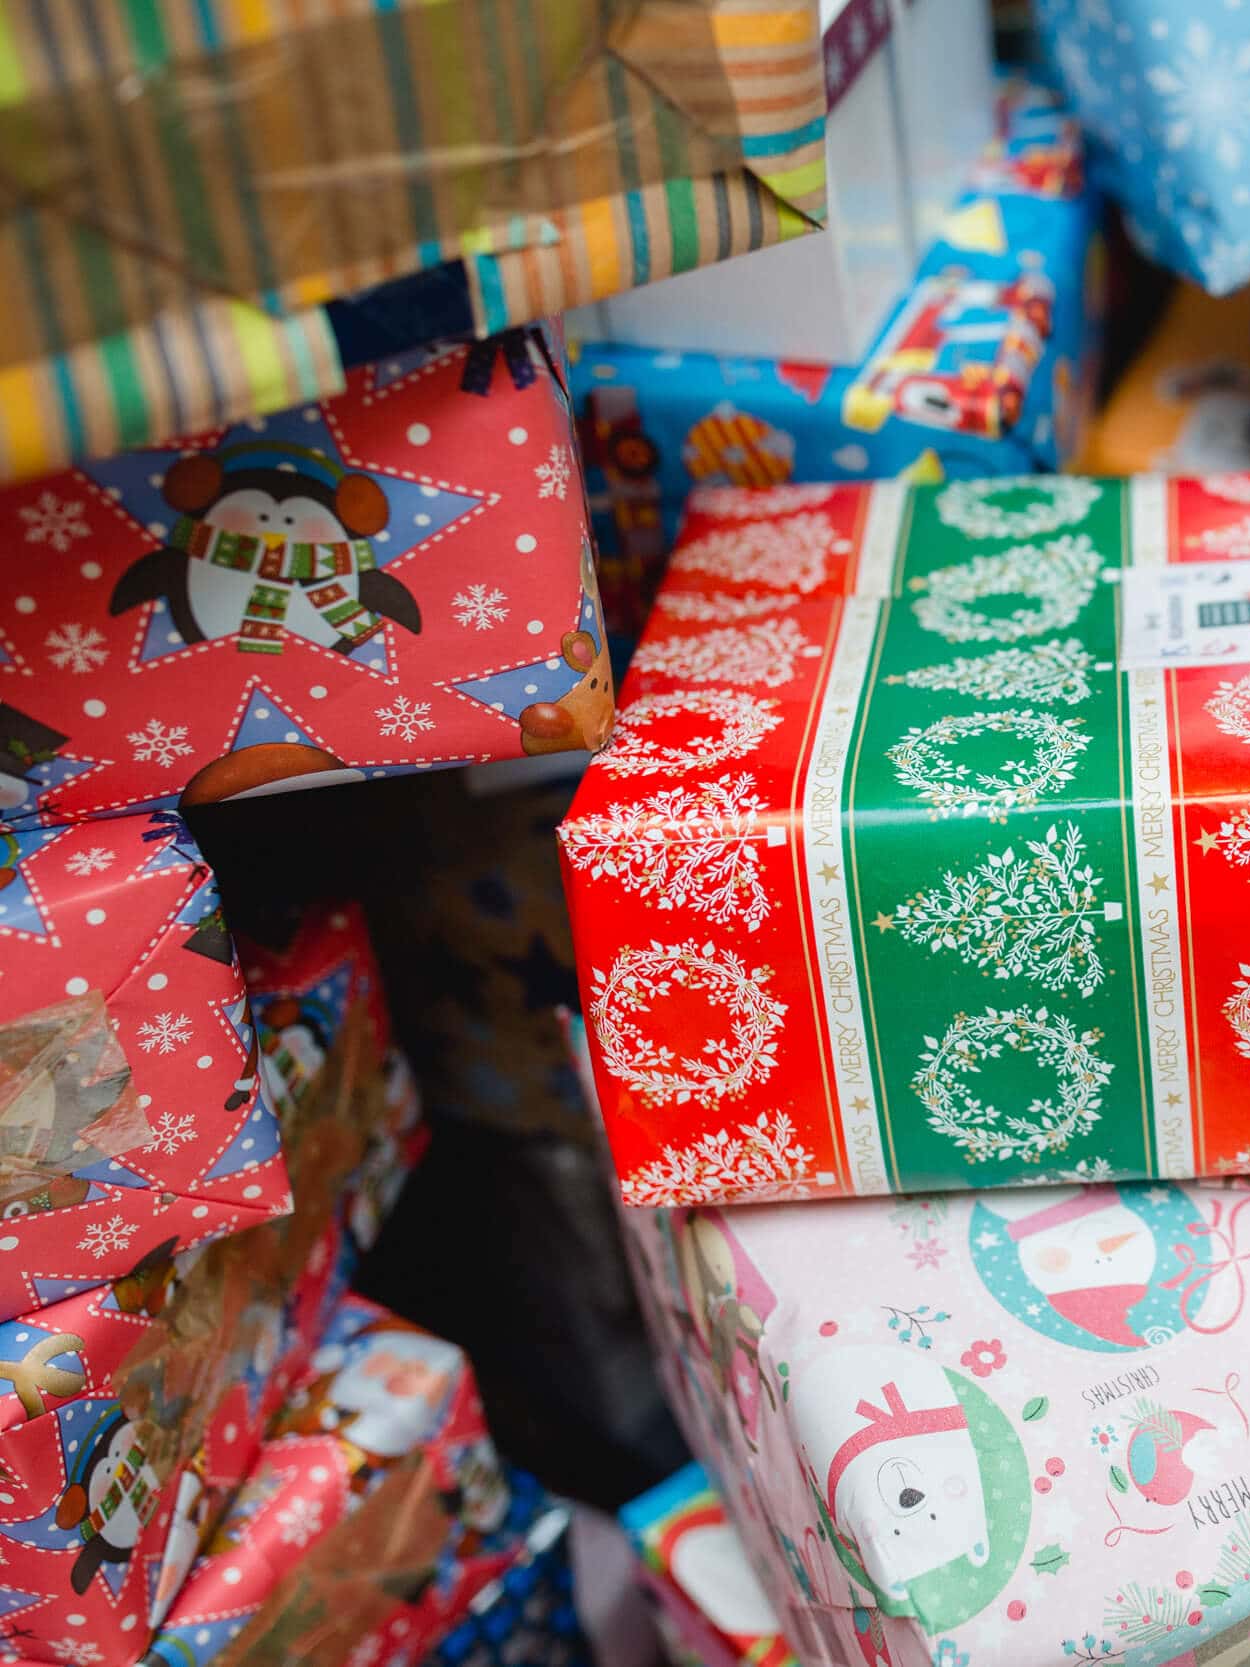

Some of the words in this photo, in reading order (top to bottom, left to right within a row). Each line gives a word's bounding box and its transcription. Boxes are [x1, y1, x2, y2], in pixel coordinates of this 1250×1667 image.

[810, 782, 837, 847] MERRY
[819, 897, 854, 1014] CHRISTMAS
[1148, 908, 1177, 1017] CHRISTMAS
[835, 1021, 866, 1085] MERRY
[1155, 1024, 1180, 1083] MERRY
[1081, 1365, 1160, 1411] CHRISTMAS
